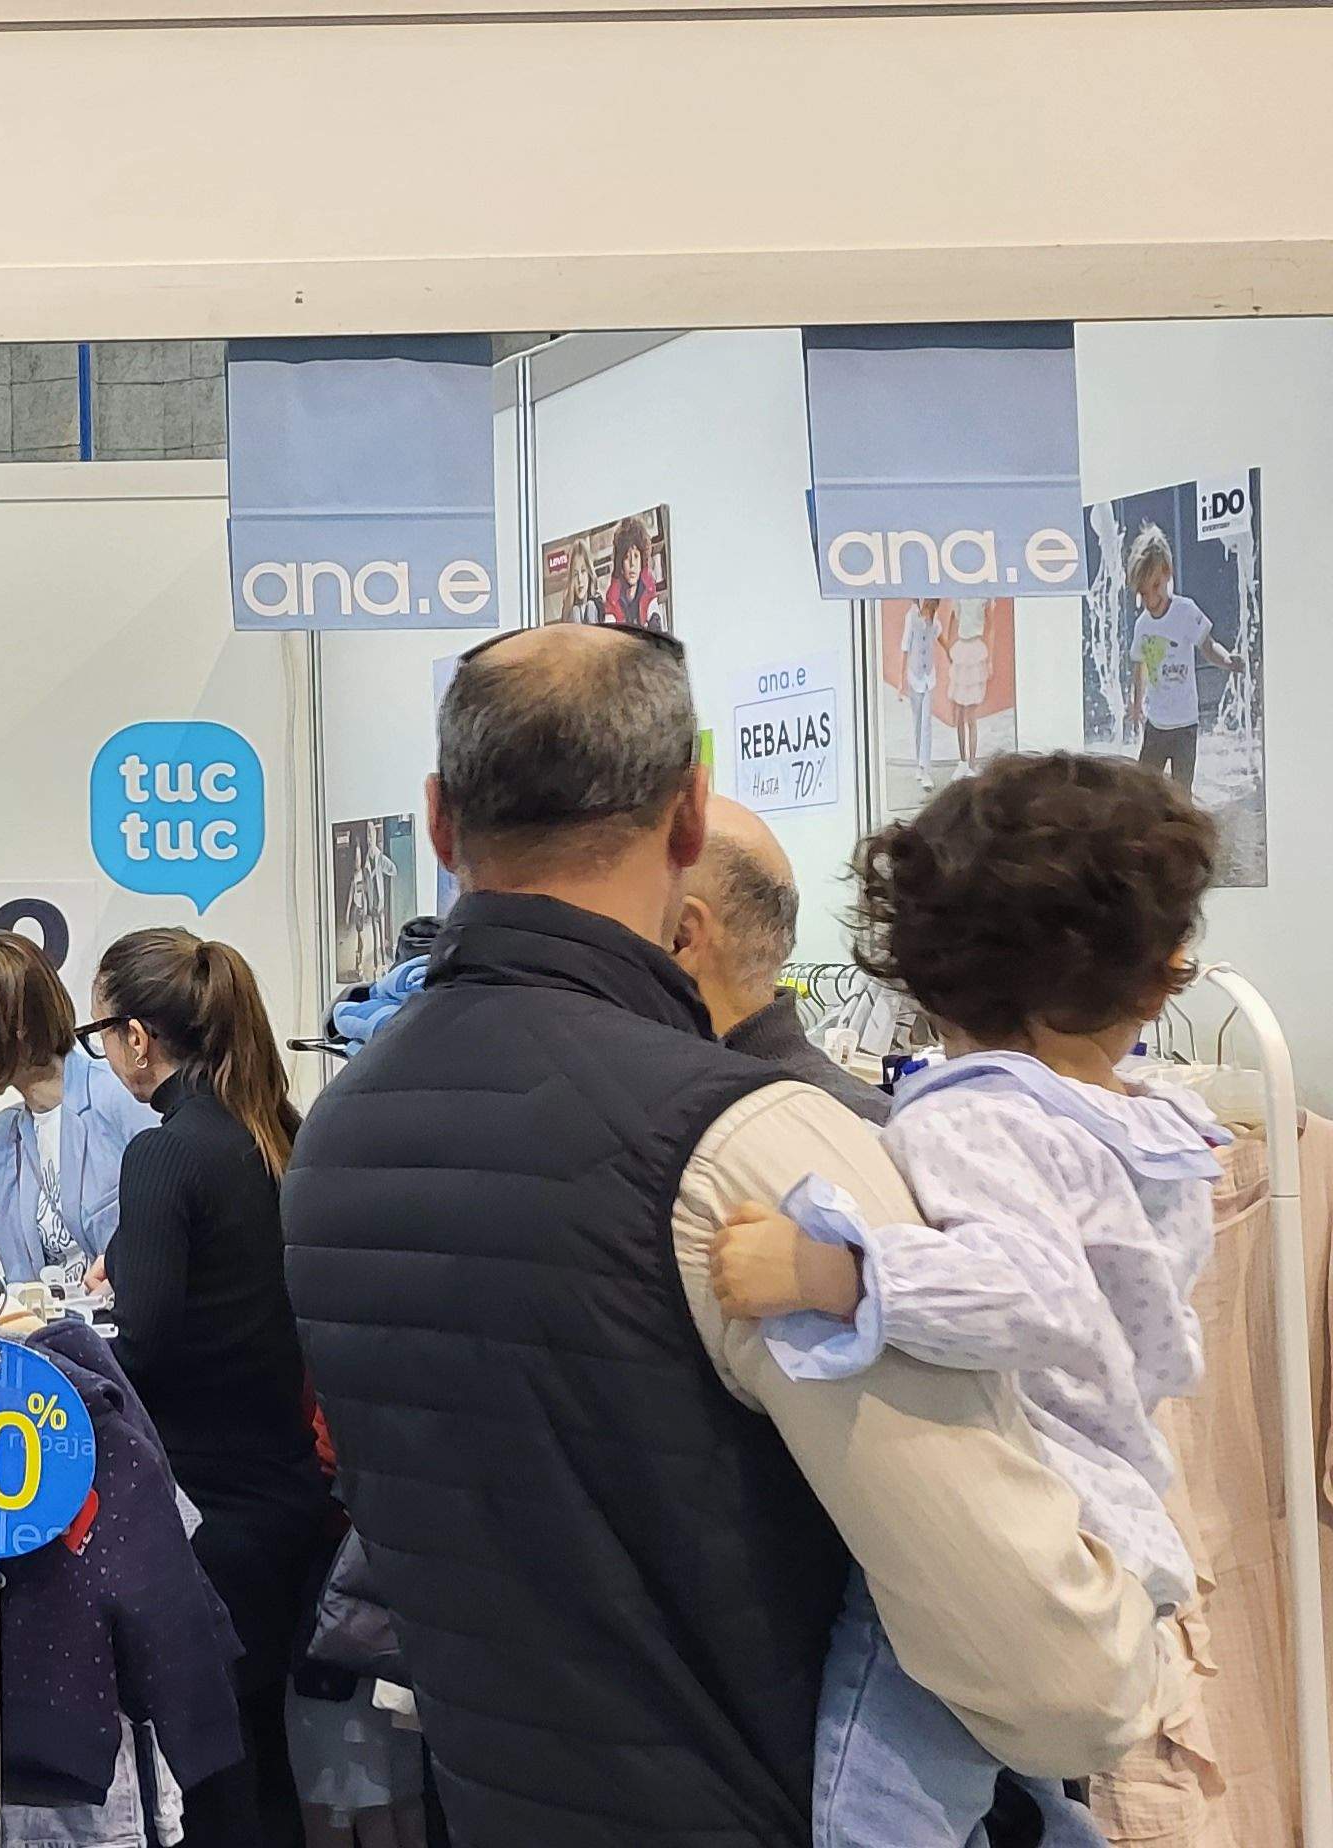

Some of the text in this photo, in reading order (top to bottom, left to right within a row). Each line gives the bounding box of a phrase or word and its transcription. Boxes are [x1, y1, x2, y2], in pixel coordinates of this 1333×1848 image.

[826, 526, 1081, 587] ana.e
[241, 559, 491, 617] ana.e
[758, 667, 806, 694] ana.e
[740, 711, 831, 760] REBAJAS
[118, 754, 237, 803] tuc
[791, 755, 826, 800] 70%
[119, 812, 239, 861] tuc
